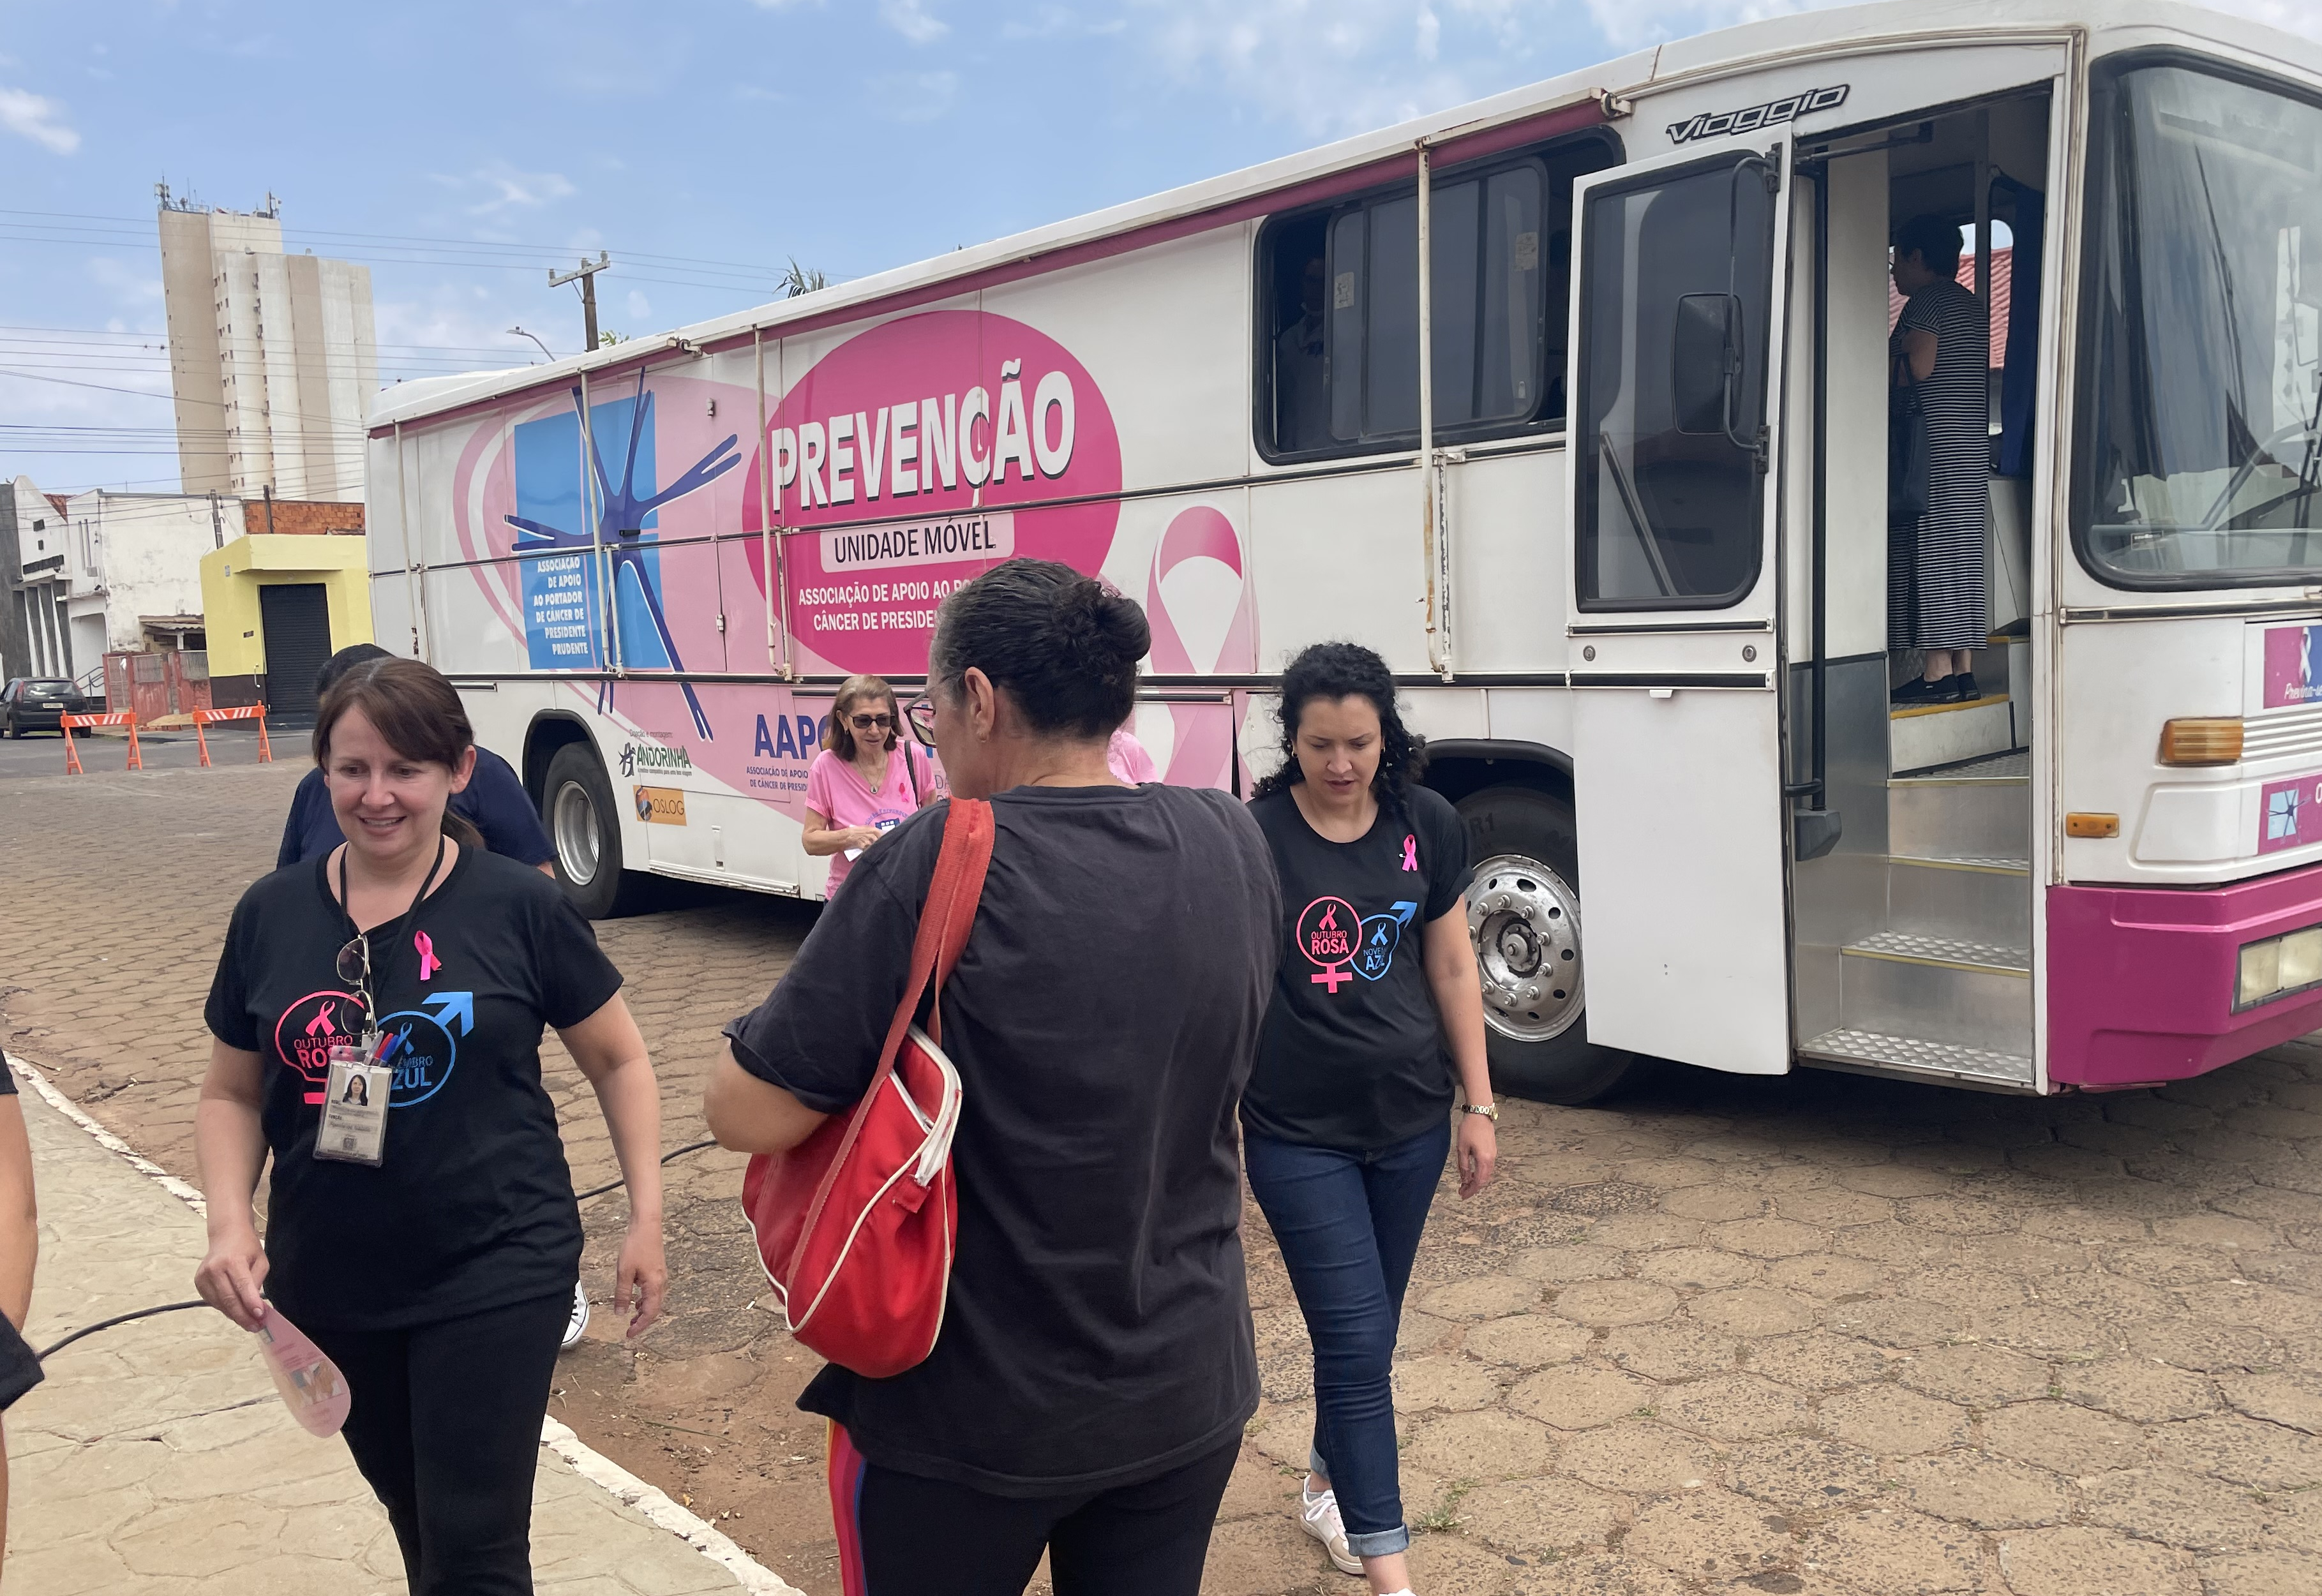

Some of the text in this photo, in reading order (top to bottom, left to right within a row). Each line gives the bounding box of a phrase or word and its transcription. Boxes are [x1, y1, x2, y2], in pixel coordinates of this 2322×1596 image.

[1666, 84, 1850, 144] Viaggio
[771, 358, 1075, 514] PREVENÇÃO
[834, 516, 996, 563] UNIDADE MÓVEL
[548, 574, 581, 588] DE APOIO
[534, 591, 583, 606] AO PORTADOR
[798, 581, 869, 608] ASSOCIAÇÃO
[873, 584, 889, 602] DE
[892, 581, 929, 601] APOIO
[933, 580, 950, 599] AO
[536, 607, 584, 623] DE CÂNCER DE
[814, 609, 937, 631] CÂNCER DE PRESIDE
[544, 625, 586, 639] PRESIDENTE
[552, 642, 588, 655] PRUDENTE
[637, 743, 692, 768] ANDORINHA
[747, 766, 808, 779] ASSOCIAÇÃO DE APOIO
[750, 777, 807, 791] DE CÂNCER DE PRESID
[653, 798, 685, 816] OSLOG
[1311, 930, 1347, 939] OUTUBRO
[1312, 939, 1349, 955] ROSA
[294, 1035, 353, 1049] OUTUBRO
[391, 1067, 432, 1090] ZUL
